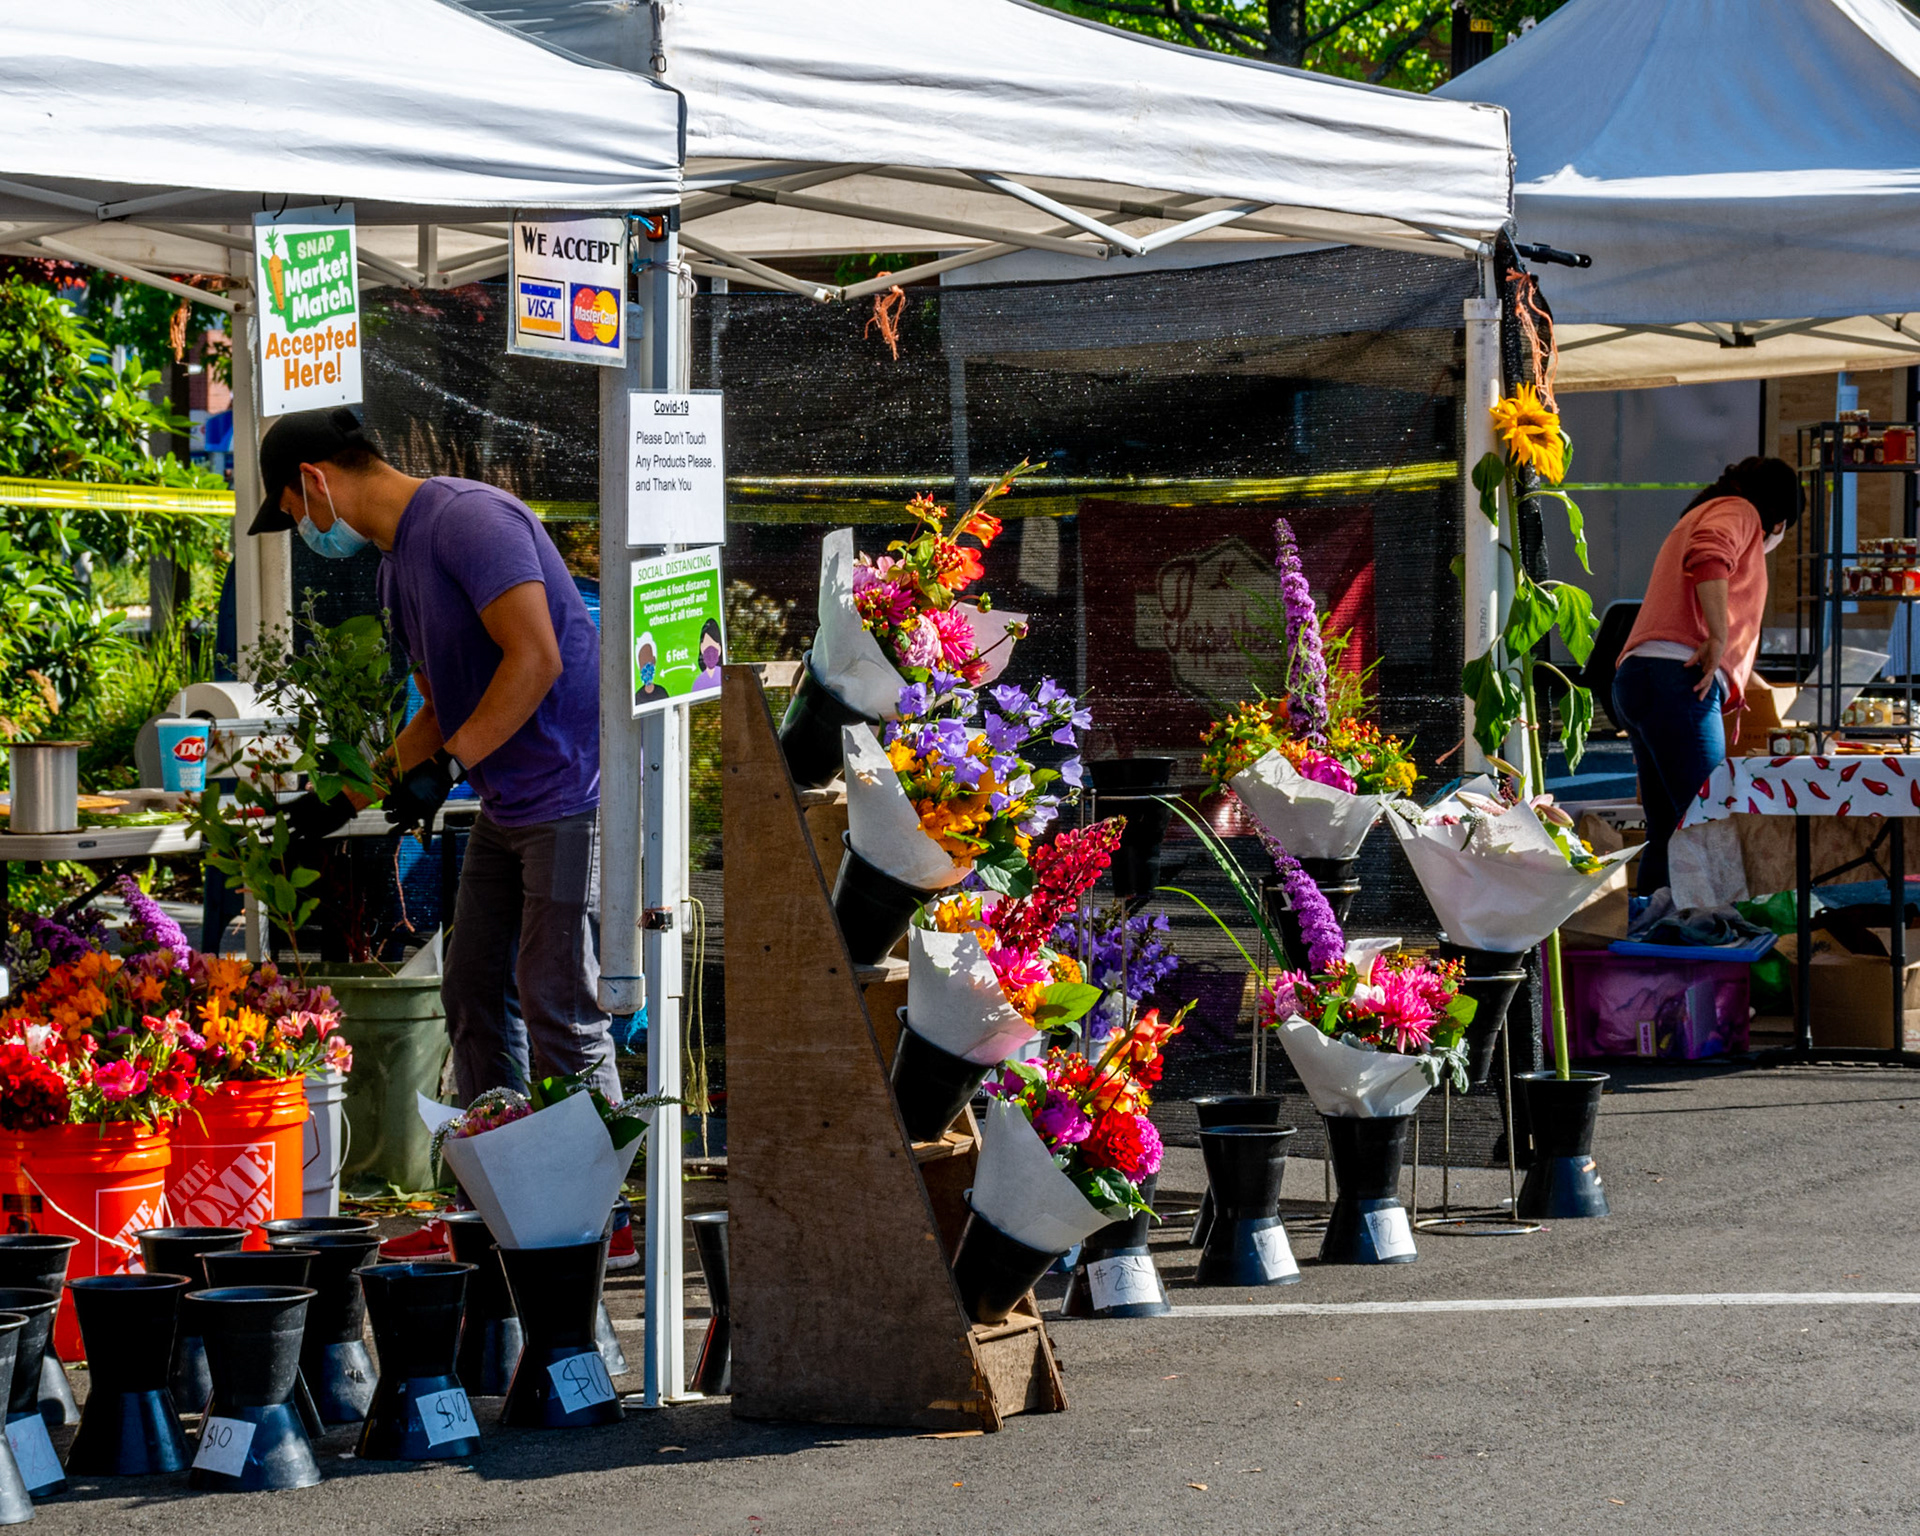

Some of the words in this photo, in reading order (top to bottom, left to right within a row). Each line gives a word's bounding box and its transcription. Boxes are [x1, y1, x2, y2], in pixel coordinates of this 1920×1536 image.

[297, 234, 335, 260] SNAP
[521, 225, 547, 256] WE
[552, 235, 619, 265] ACCEPT
[284, 251, 349, 297] Market
[292, 281, 352, 323] Match
[527, 297, 555, 319] VISA
[573, 305, 617, 326] MasterCard
[265, 321, 357, 361] Accepted
[284, 352, 341, 391] Here!
[654, 399, 689, 414] Covid-19
[636, 431, 662, 445] Please
[664, 431, 684, 445] Don't
[685, 431, 706, 445] Touch
[635, 454, 651, 471] Any
[653, 454, 686, 468] Products
[635, 478, 651, 491] and
[653, 477, 677, 491] Thank
[677, 477, 692, 491] You
[638, 565, 664, 581] SOCIAL
[665, 555, 712, 576] DISTANCING
[640, 586, 667, 602] maintain
[667, 585, 672, 596] 6
[672, 583, 685, 595] foot
[685, 579, 711, 592] distance
[643, 600, 670, 614] between
[670, 592, 695, 611] yourself
[696, 590, 708, 603] and
[649, 614, 669, 627] others
[670, 613, 677, 622] at
[677, 609, 685, 620] all
[686, 606, 703, 619] times
[666, 650, 672, 663] 6
[672, 648, 689, 661] Feet
[168, 1159, 217, 1207] THE
[174, 1145, 273, 1227] OME
[110, 1199, 153, 1254] THE
[562, 1354, 611, 1404] $10
[436, 1391, 468, 1430] $10
[205, 1423, 232, 1453] $10
